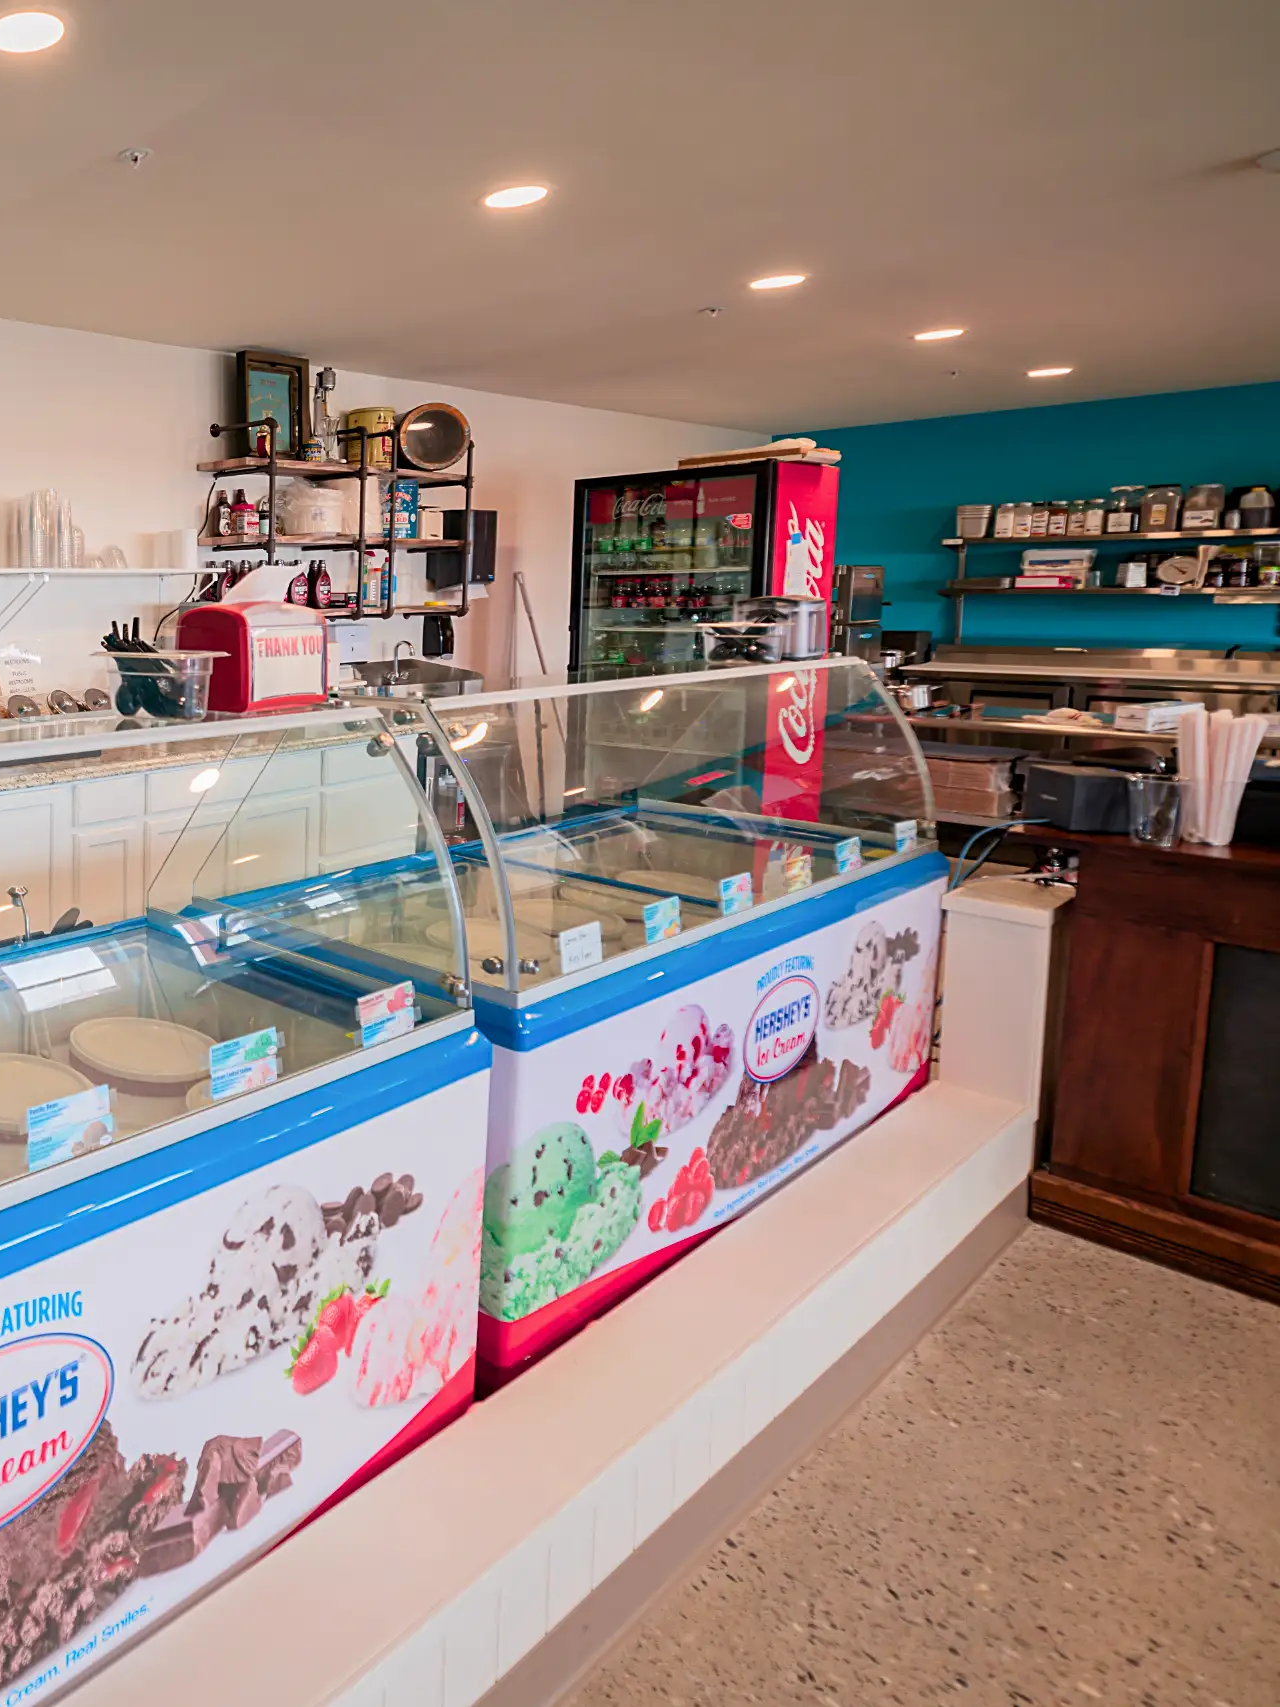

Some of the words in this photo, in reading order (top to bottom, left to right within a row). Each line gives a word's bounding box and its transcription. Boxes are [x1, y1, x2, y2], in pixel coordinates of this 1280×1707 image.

[255, 635, 300, 658] THANK
[300, 634, 323, 656] YOU
[755, 962, 784, 995] PROUDLY
[784, 954, 815, 975] FEATURING
[754, 995, 812, 1044] HERSHEY'S
[755, 1046, 770, 1068] Ice
[773, 1032, 806, 1059] Cream
[5, 1665, 61, 1707] Cream.
[64, 1634, 98, 1669] Real
[100, 1600, 151, 1644] Smiles.
